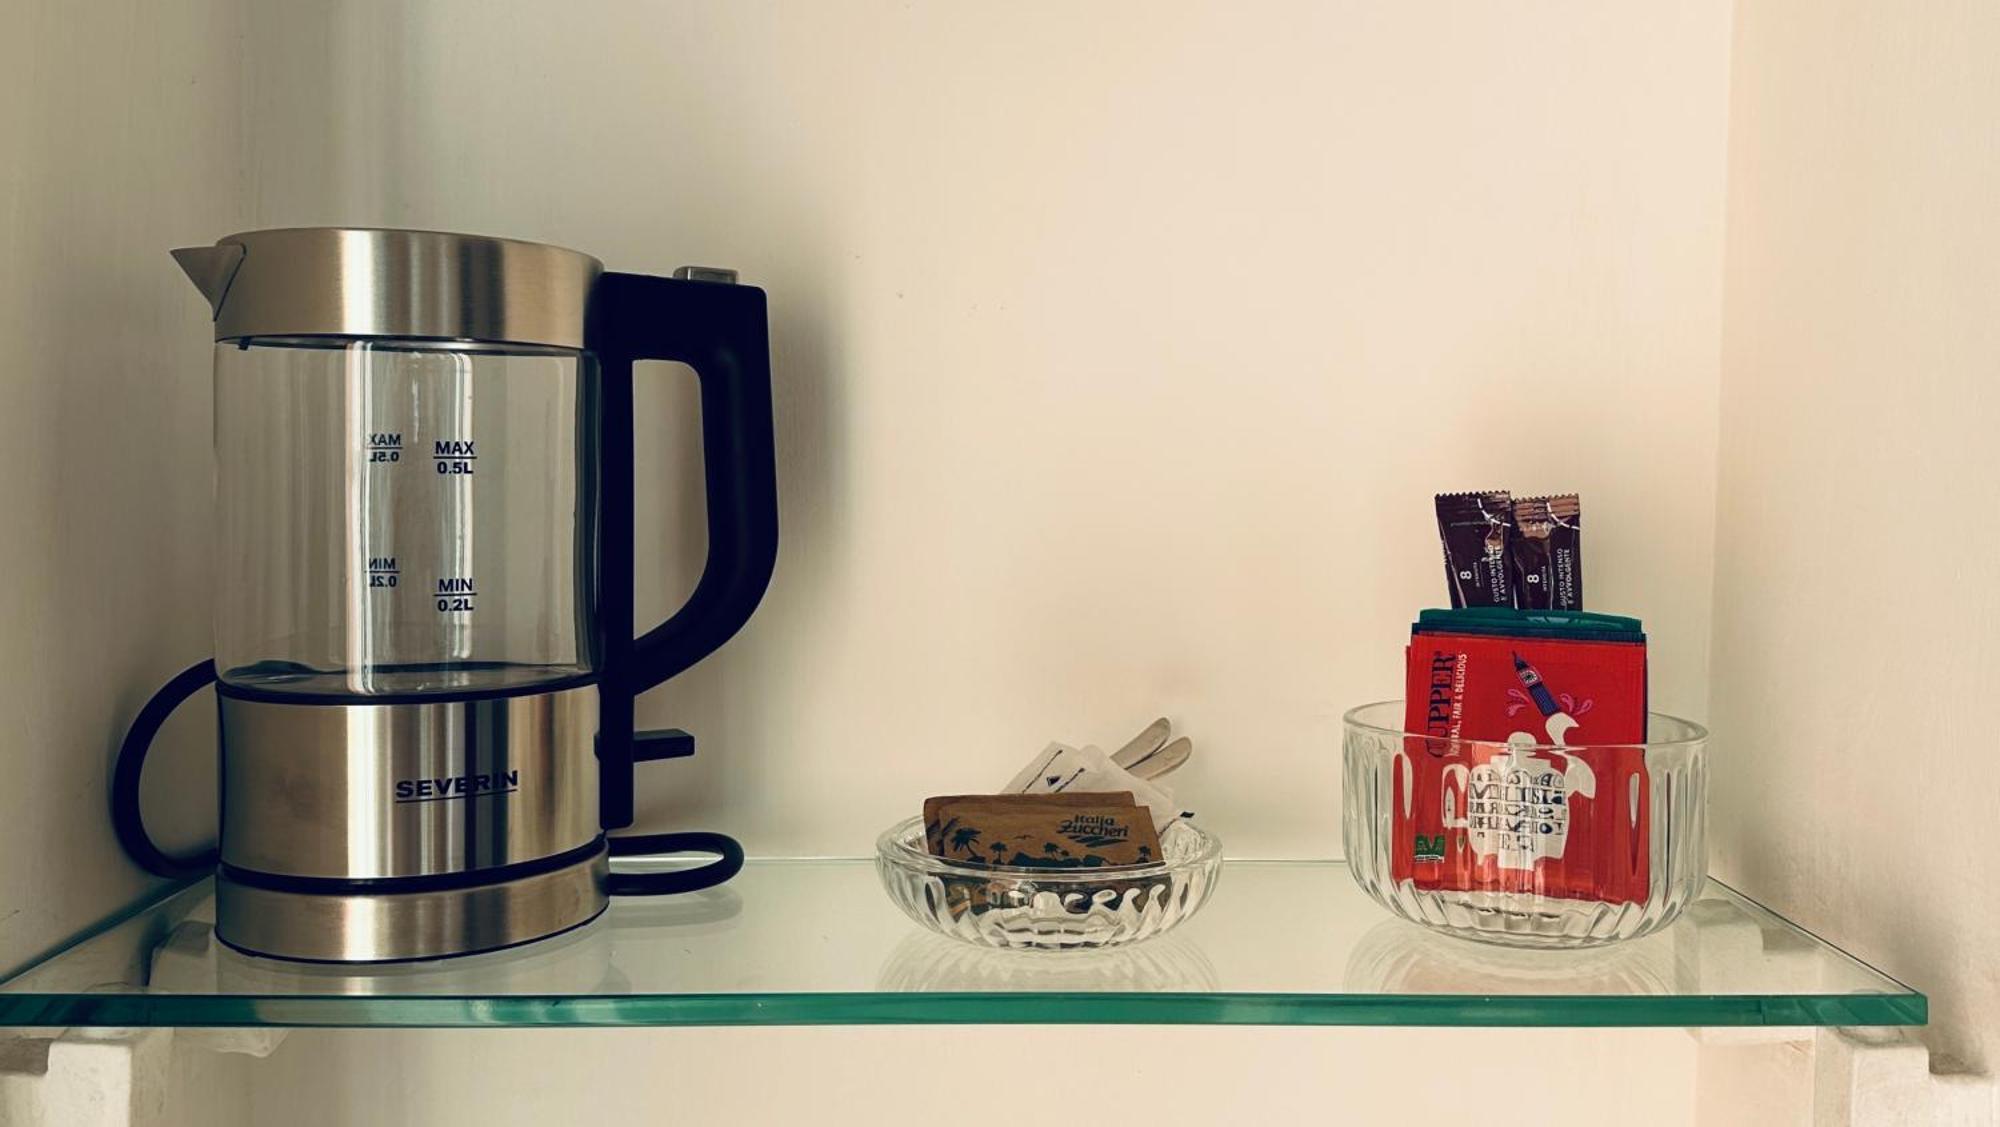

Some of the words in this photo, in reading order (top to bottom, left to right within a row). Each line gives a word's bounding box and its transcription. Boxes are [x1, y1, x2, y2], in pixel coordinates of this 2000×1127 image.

[435, 441, 474, 455] MAX
[437, 462, 474, 474] 0.5L
[1556, 548, 1565, 580] INTENSO
[1460, 570, 1472, 580] 8
[1527, 574, 1540, 584] 8
[1564, 549, 1573, 598] AVVOLGENTE
[438, 579, 473, 592] MIN
[1491, 577, 1500, 603] GUSTO
[1559, 581, 1568, 607] GUSTO
[437, 599, 474, 611] 0.2L
[1455, 653, 1467, 693] DELICIOUS
[1452, 702, 1462, 719] FAIR
[395, 770, 518, 798] SEVERIN
[1056, 820, 1129, 837] Zuccheri
